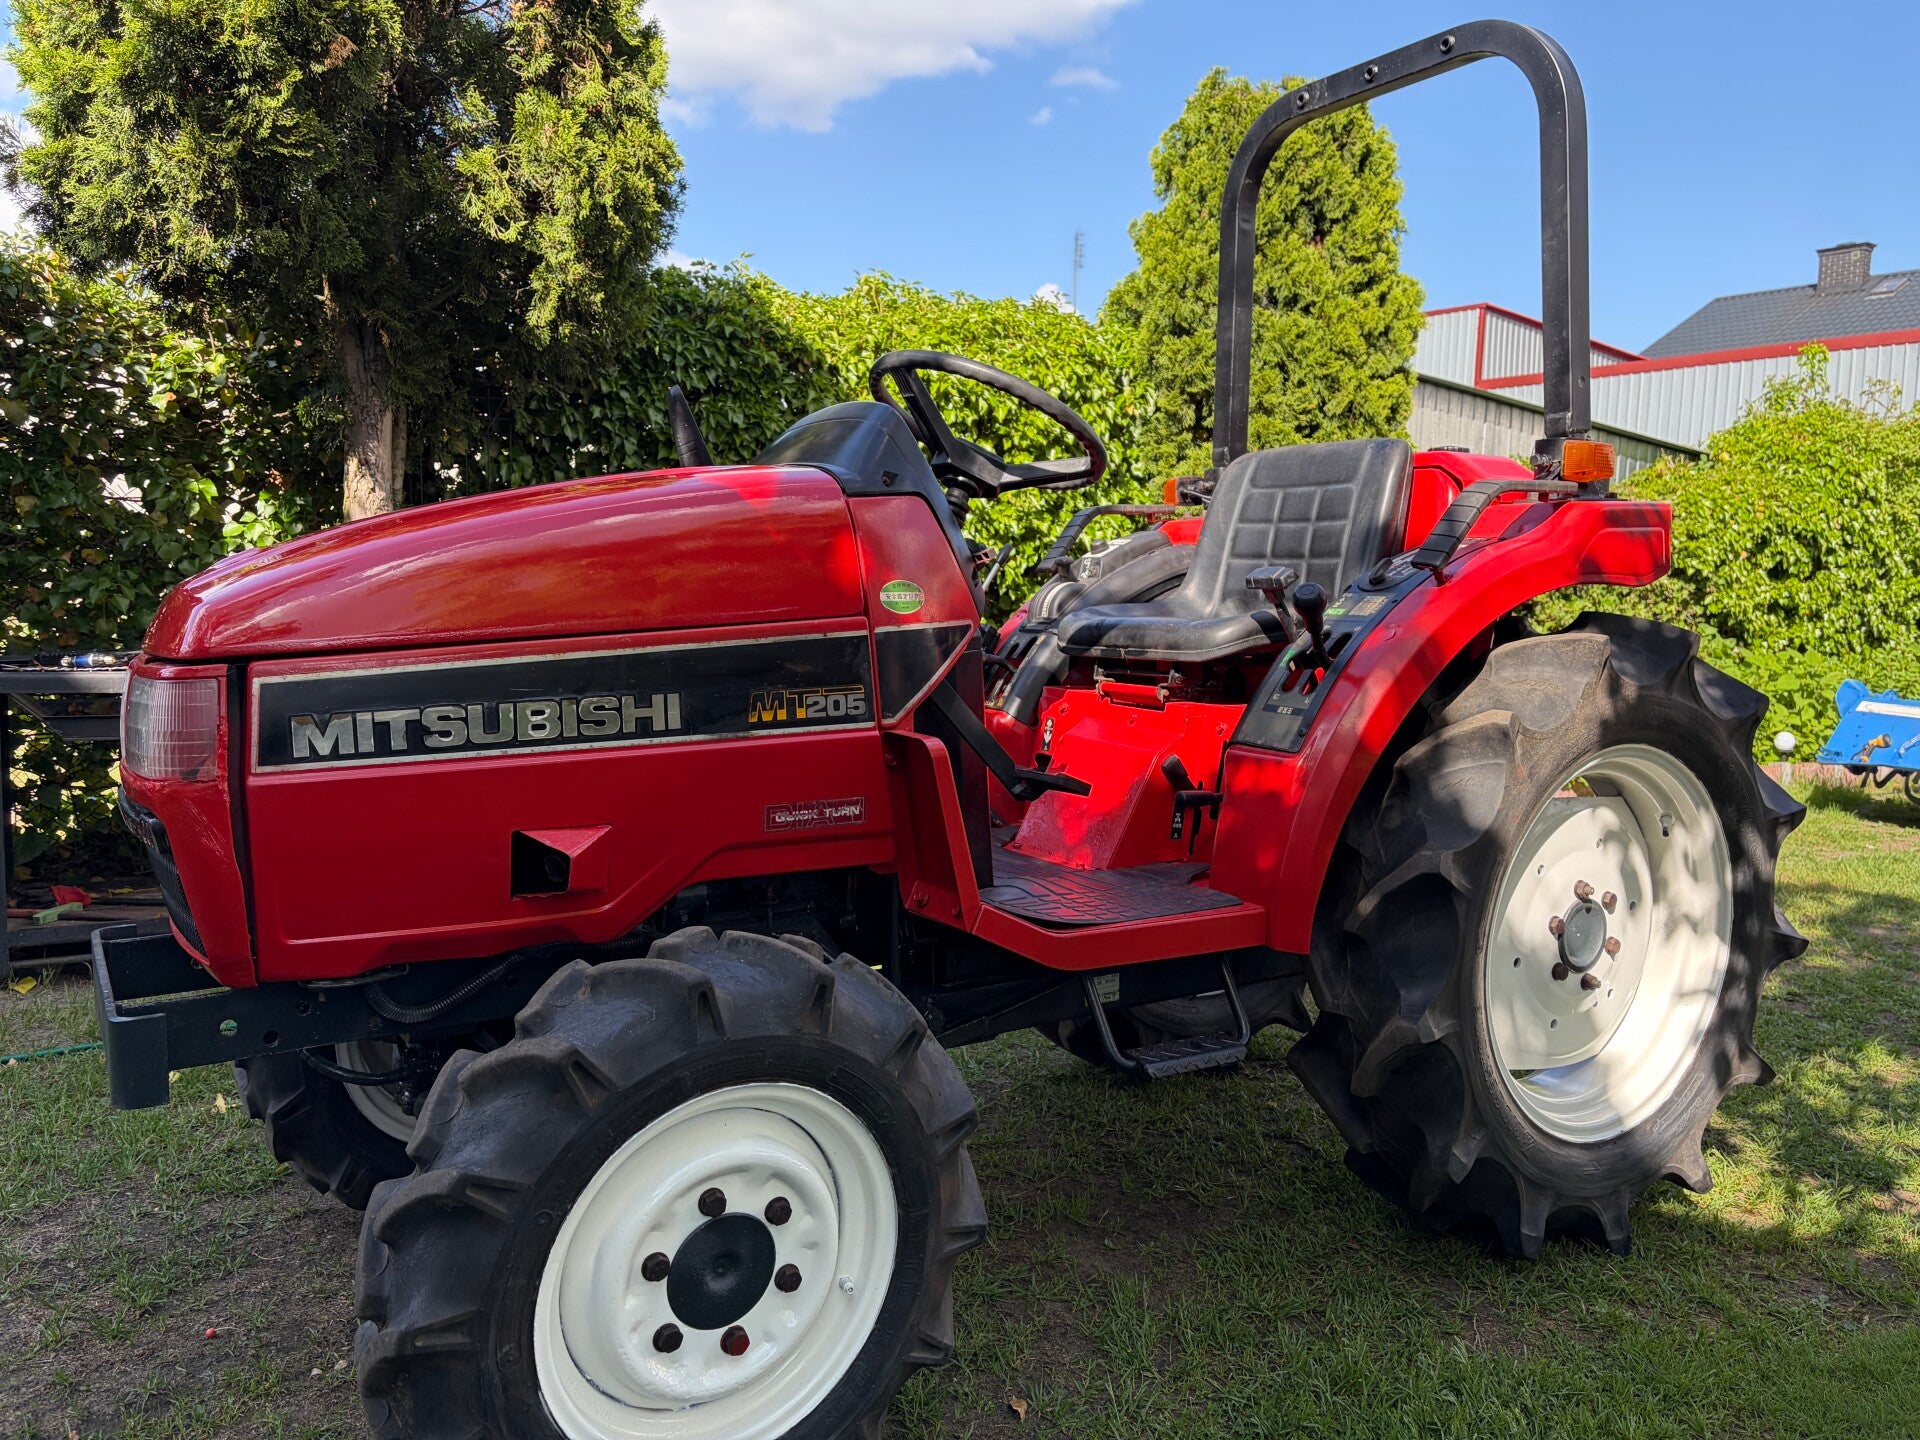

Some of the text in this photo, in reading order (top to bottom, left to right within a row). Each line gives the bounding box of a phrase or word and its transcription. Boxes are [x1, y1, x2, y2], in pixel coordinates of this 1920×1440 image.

[748, 685, 867, 723] MT205
[291, 692, 682, 758] MITSUBISHI
[823, 805, 861, 818] TURN
